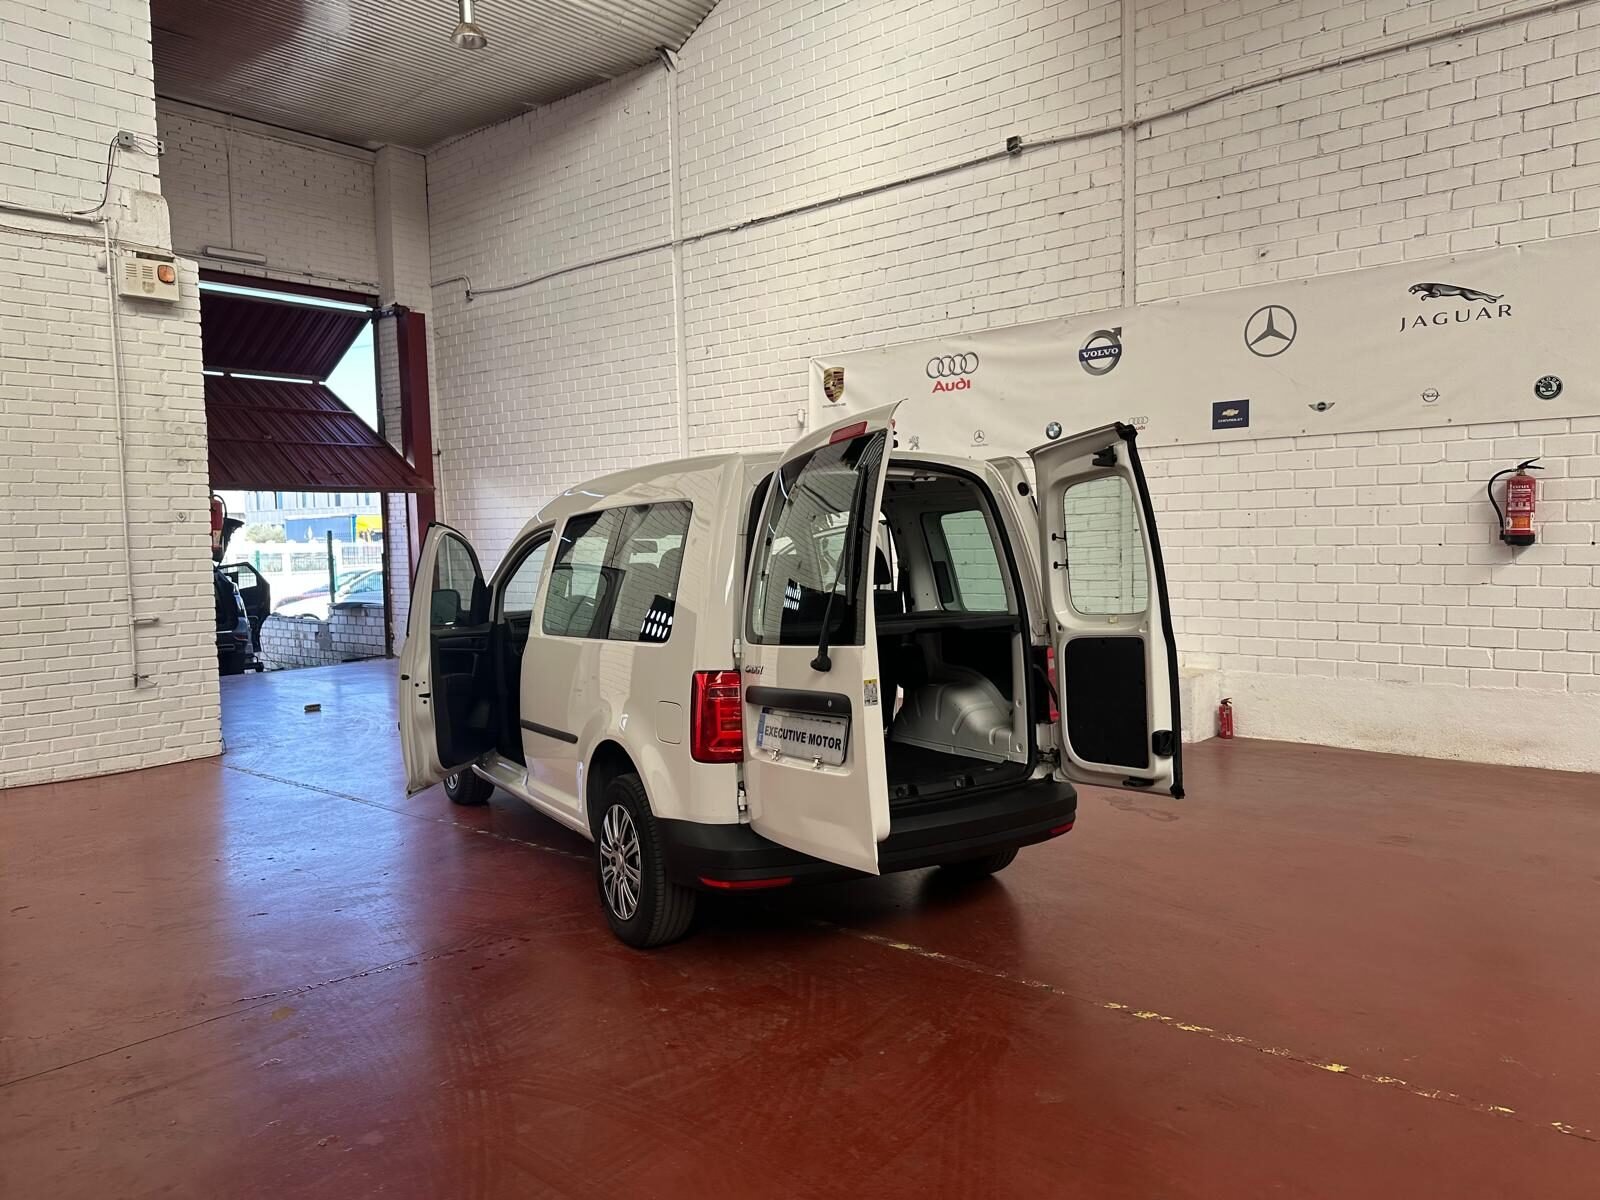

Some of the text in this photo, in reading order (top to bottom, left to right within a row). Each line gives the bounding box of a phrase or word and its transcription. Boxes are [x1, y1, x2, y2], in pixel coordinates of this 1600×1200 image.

[1400, 304, 1512, 332] JAGUAR
[1082, 347, 1119, 358] VOLVO
[932, 378, 971, 393] Audi
[764, 725, 807, 744] EXECUTIVE
[808, 733, 842, 751] MOTOR
